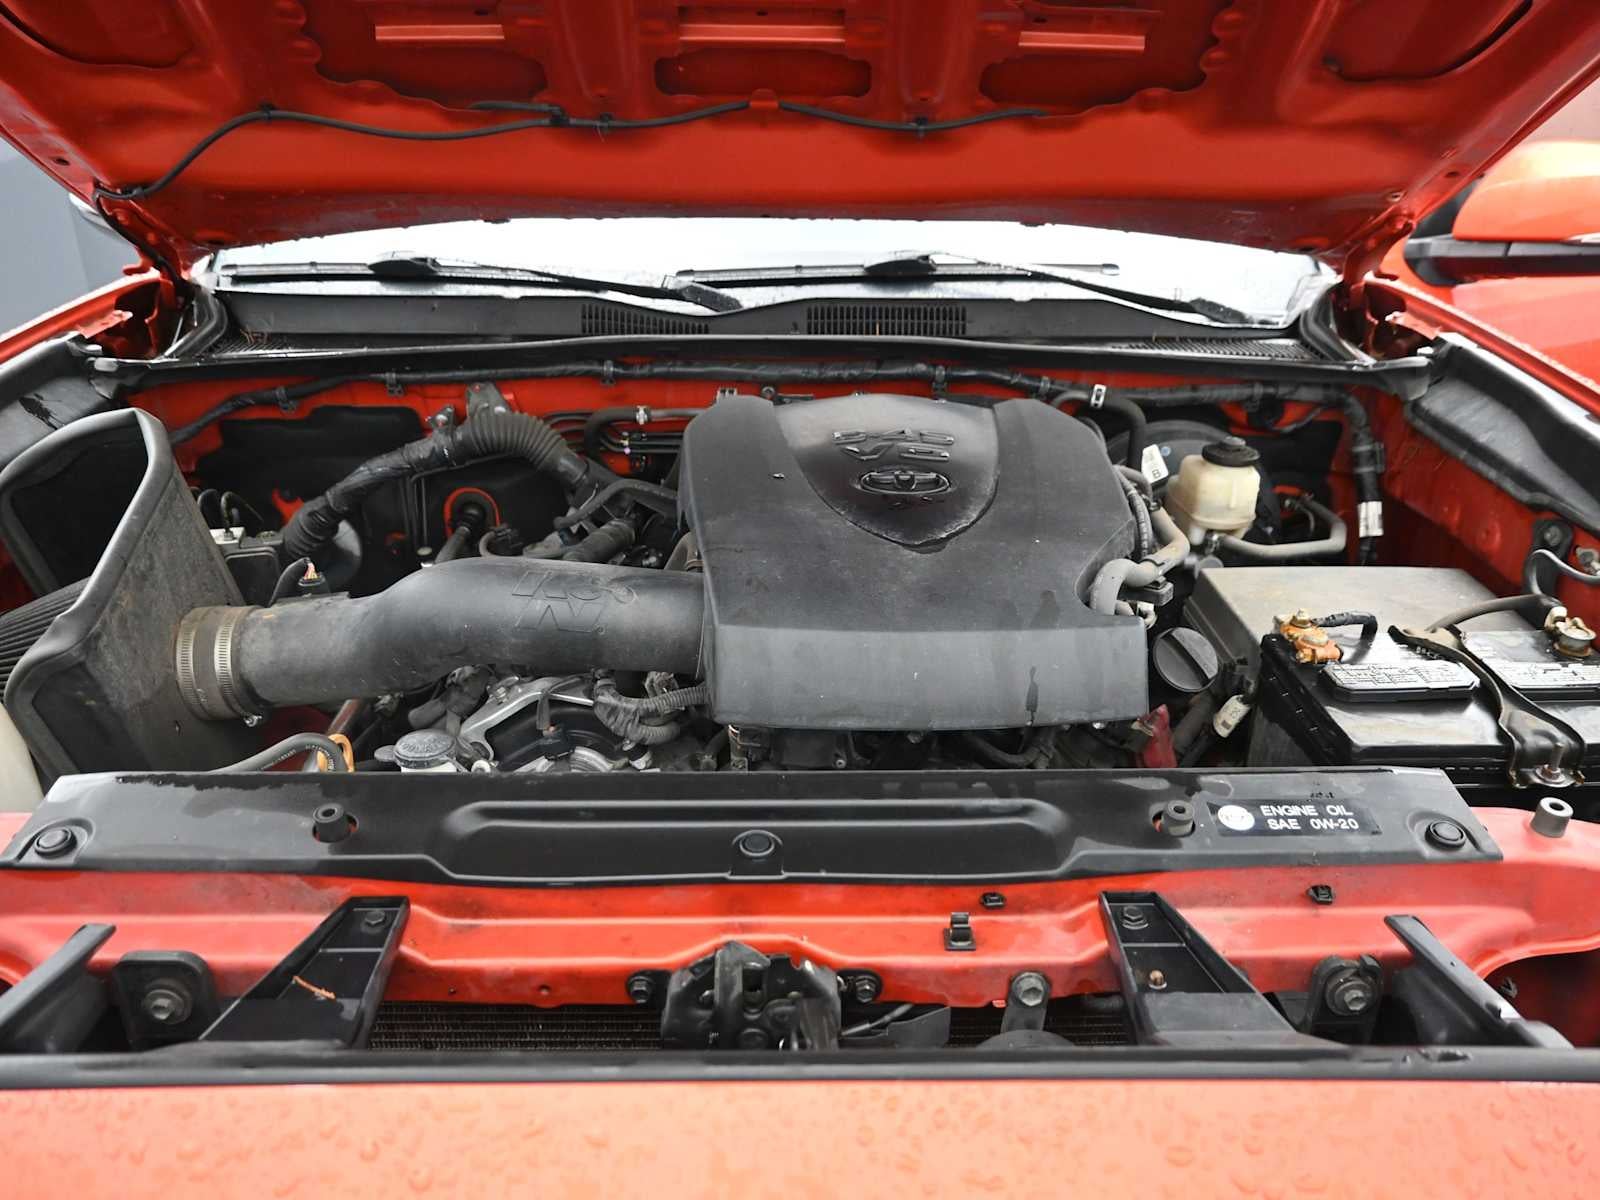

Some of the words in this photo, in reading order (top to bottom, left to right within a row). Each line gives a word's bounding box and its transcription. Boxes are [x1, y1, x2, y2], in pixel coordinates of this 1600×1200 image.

[1260, 805, 1318, 817] ENGINE
[1326, 805, 1353, 816] OIL
[1267, 818, 1301, 830] SAE
[1310, 818, 1359, 830] 0W-20
